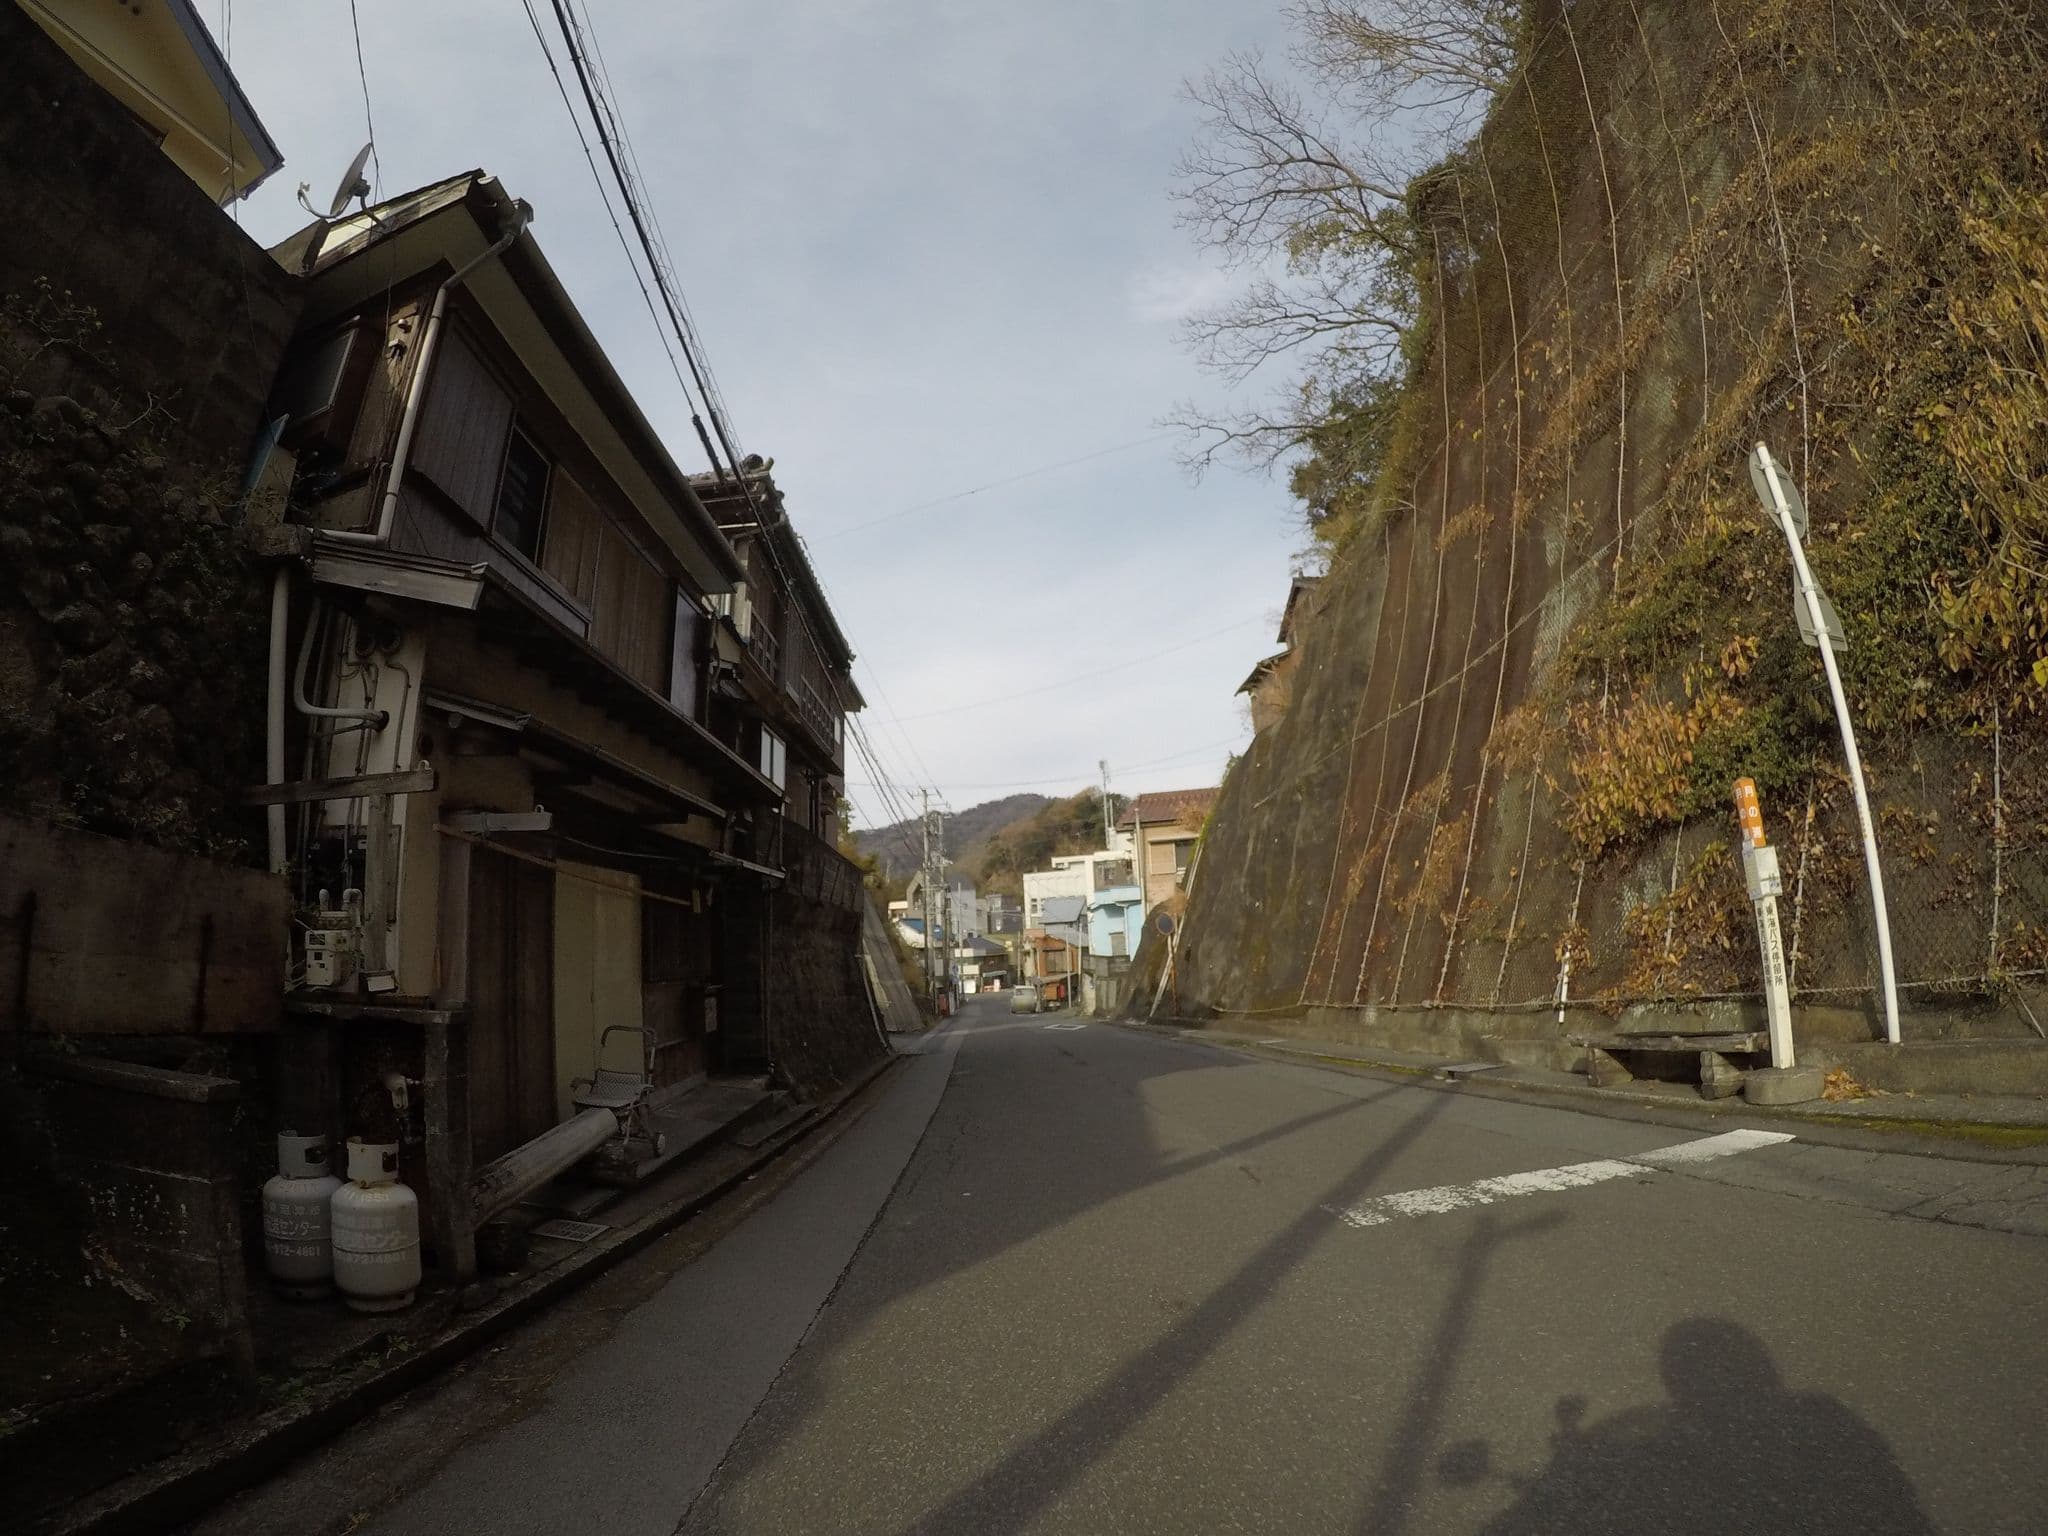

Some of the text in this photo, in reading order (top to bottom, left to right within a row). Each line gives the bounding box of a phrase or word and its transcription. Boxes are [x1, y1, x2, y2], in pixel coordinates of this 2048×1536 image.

[1766, 903, 1783, 986] 東海バス停留所
